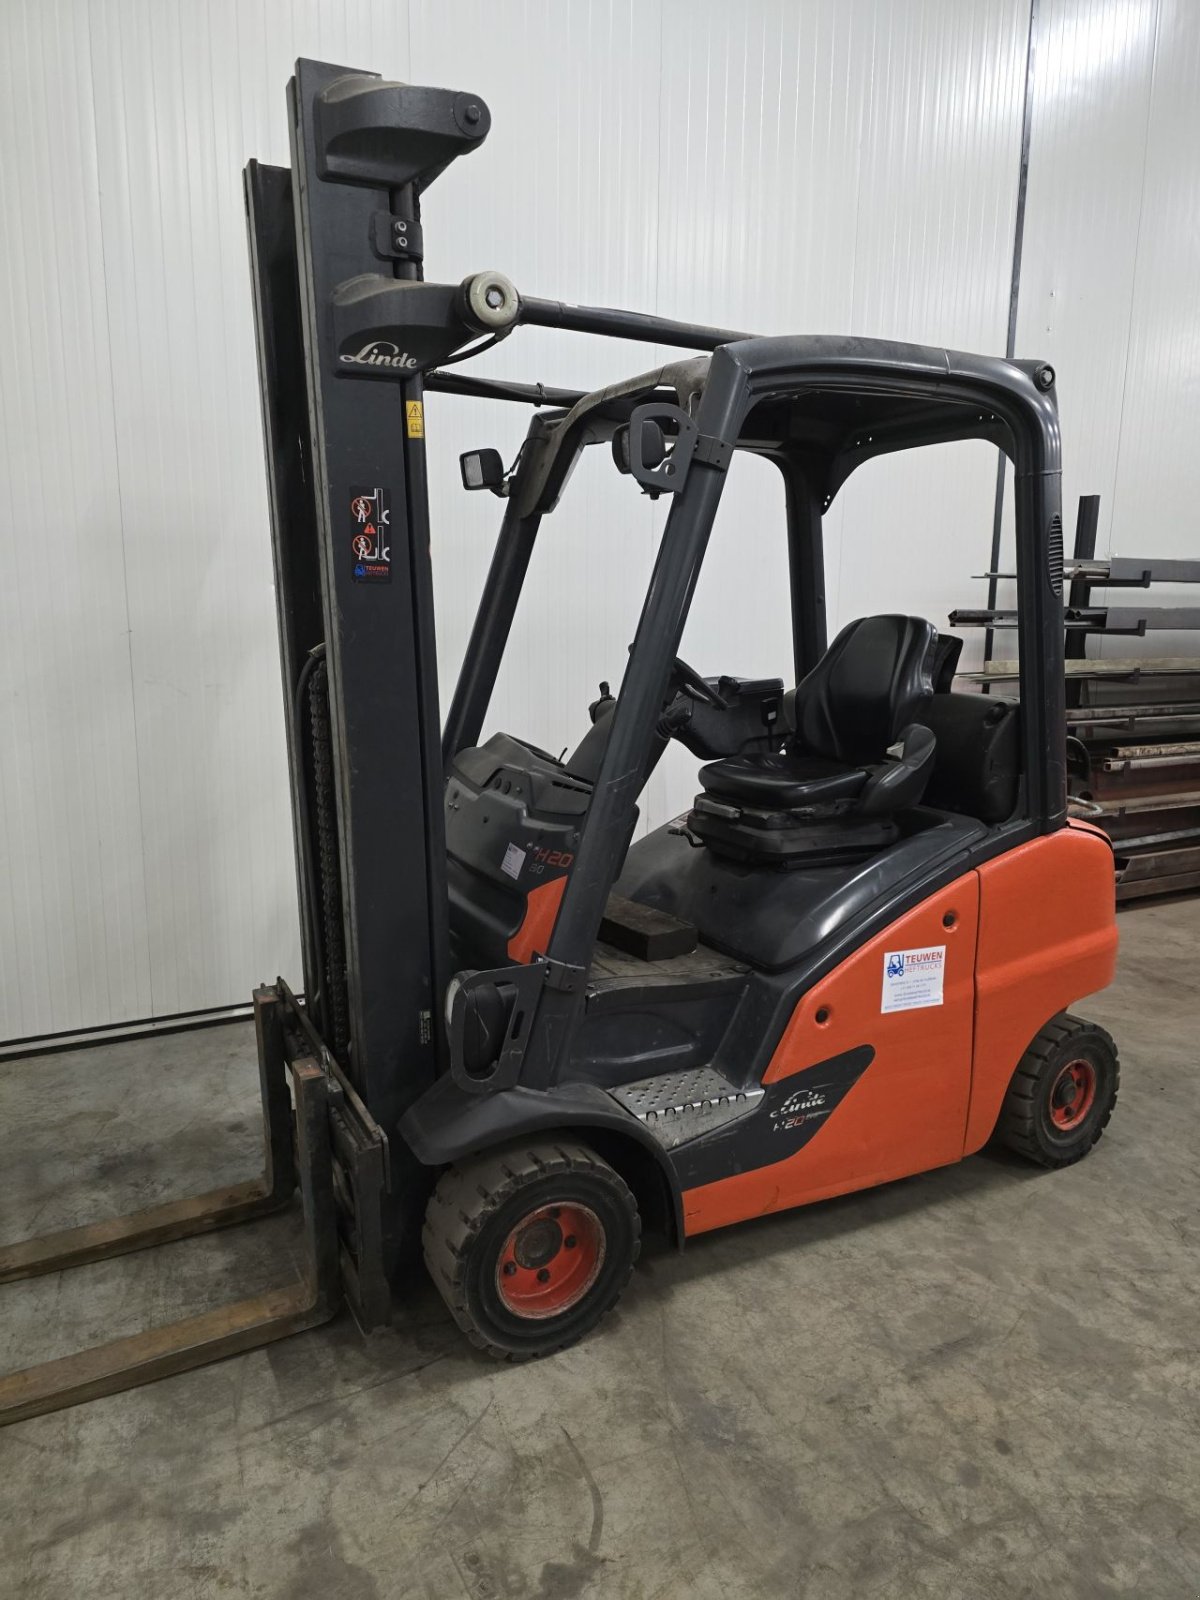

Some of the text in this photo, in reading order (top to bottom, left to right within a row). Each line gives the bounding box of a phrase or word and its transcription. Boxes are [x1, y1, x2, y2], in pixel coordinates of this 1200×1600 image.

[340, 341, 417, 369] Linde
[535, 848, 575, 868] H20
[905, 951, 943, 964] TEUWEN
